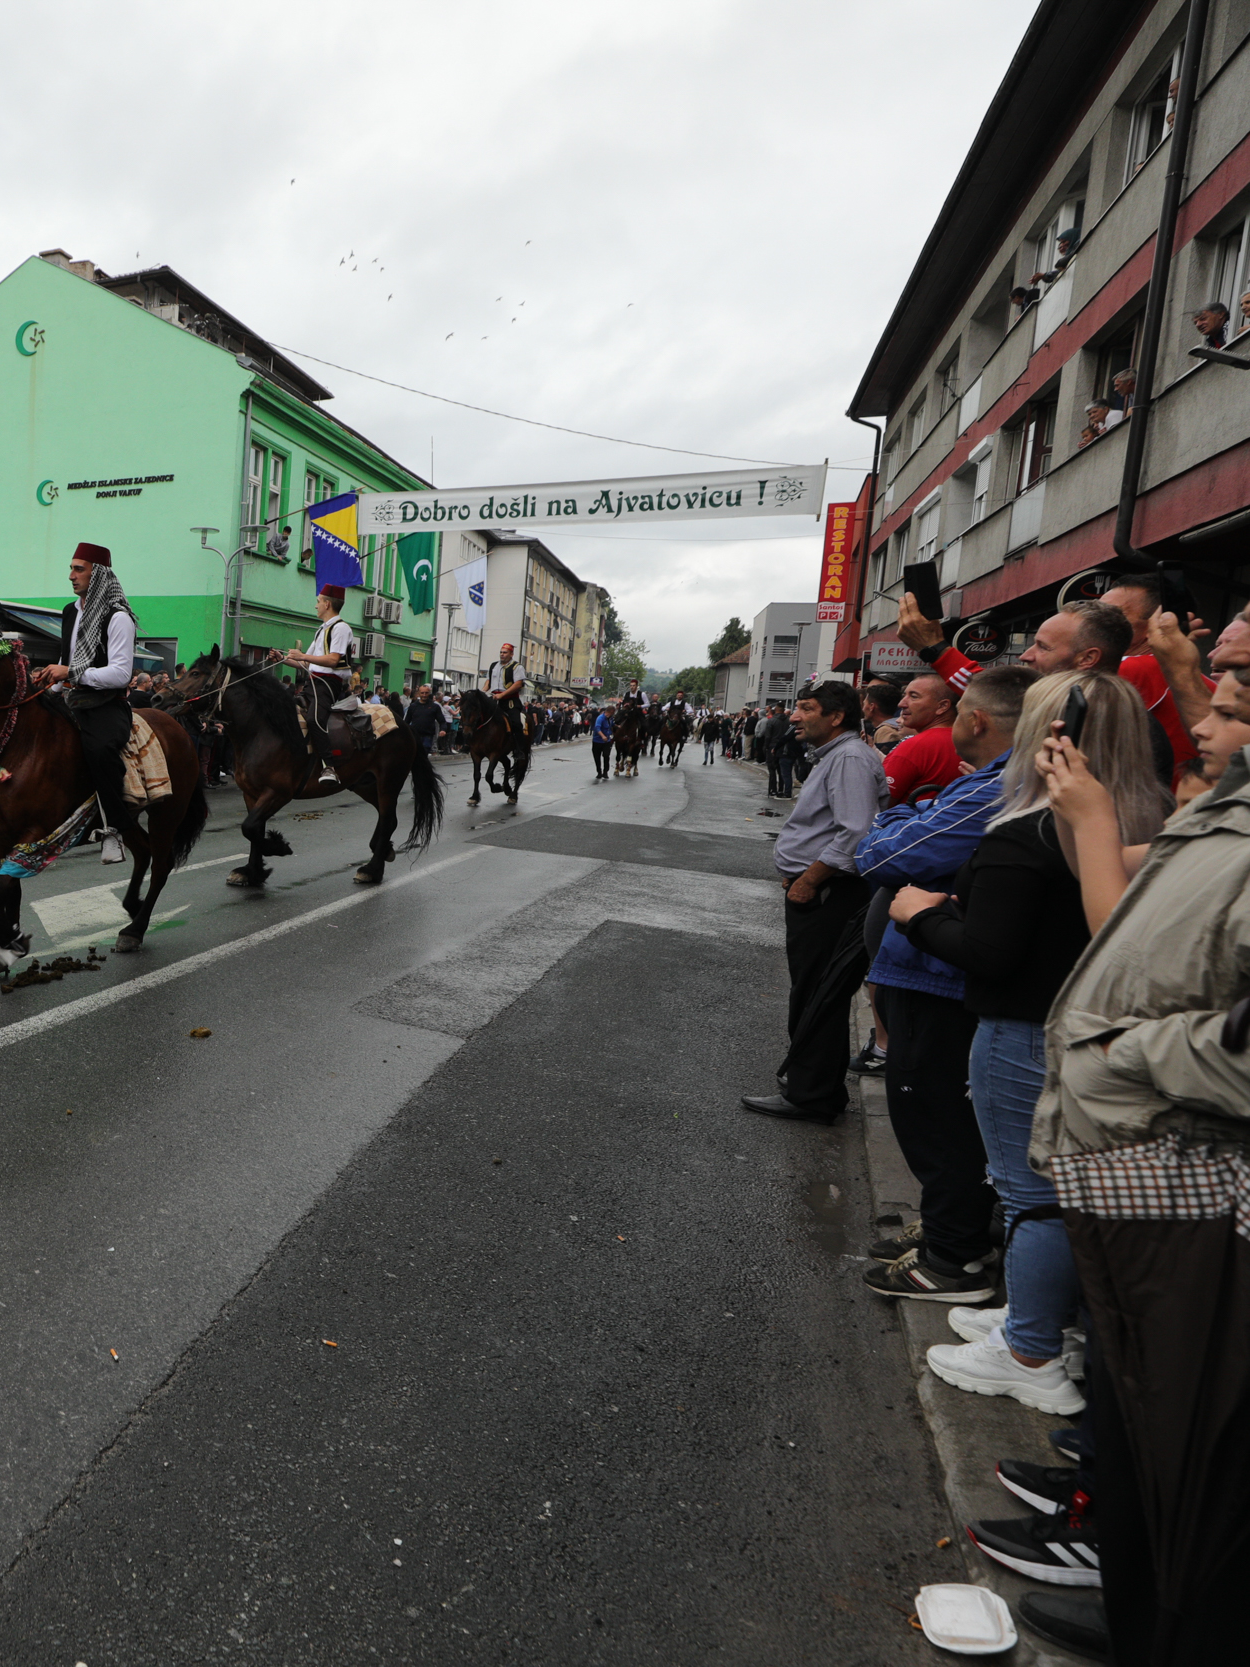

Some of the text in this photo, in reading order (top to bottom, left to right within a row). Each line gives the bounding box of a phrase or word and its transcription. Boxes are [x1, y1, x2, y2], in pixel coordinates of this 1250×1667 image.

[98, 478, 133, 488] ISLAMSKE
[134, 474, 174, 485] ZAJEDNICE
[96, 488, 143, 499] DONJI VAKUF
[398, 498, 471, 524] Dobro
[478, 493, 537, 521] došli
[546, 498, 579, 517] na
[586, 485, 744, 520] Ajvatovicu
[824, 507, 850, 599] RESTORAN
[964, 640, 998, 655] Taste
